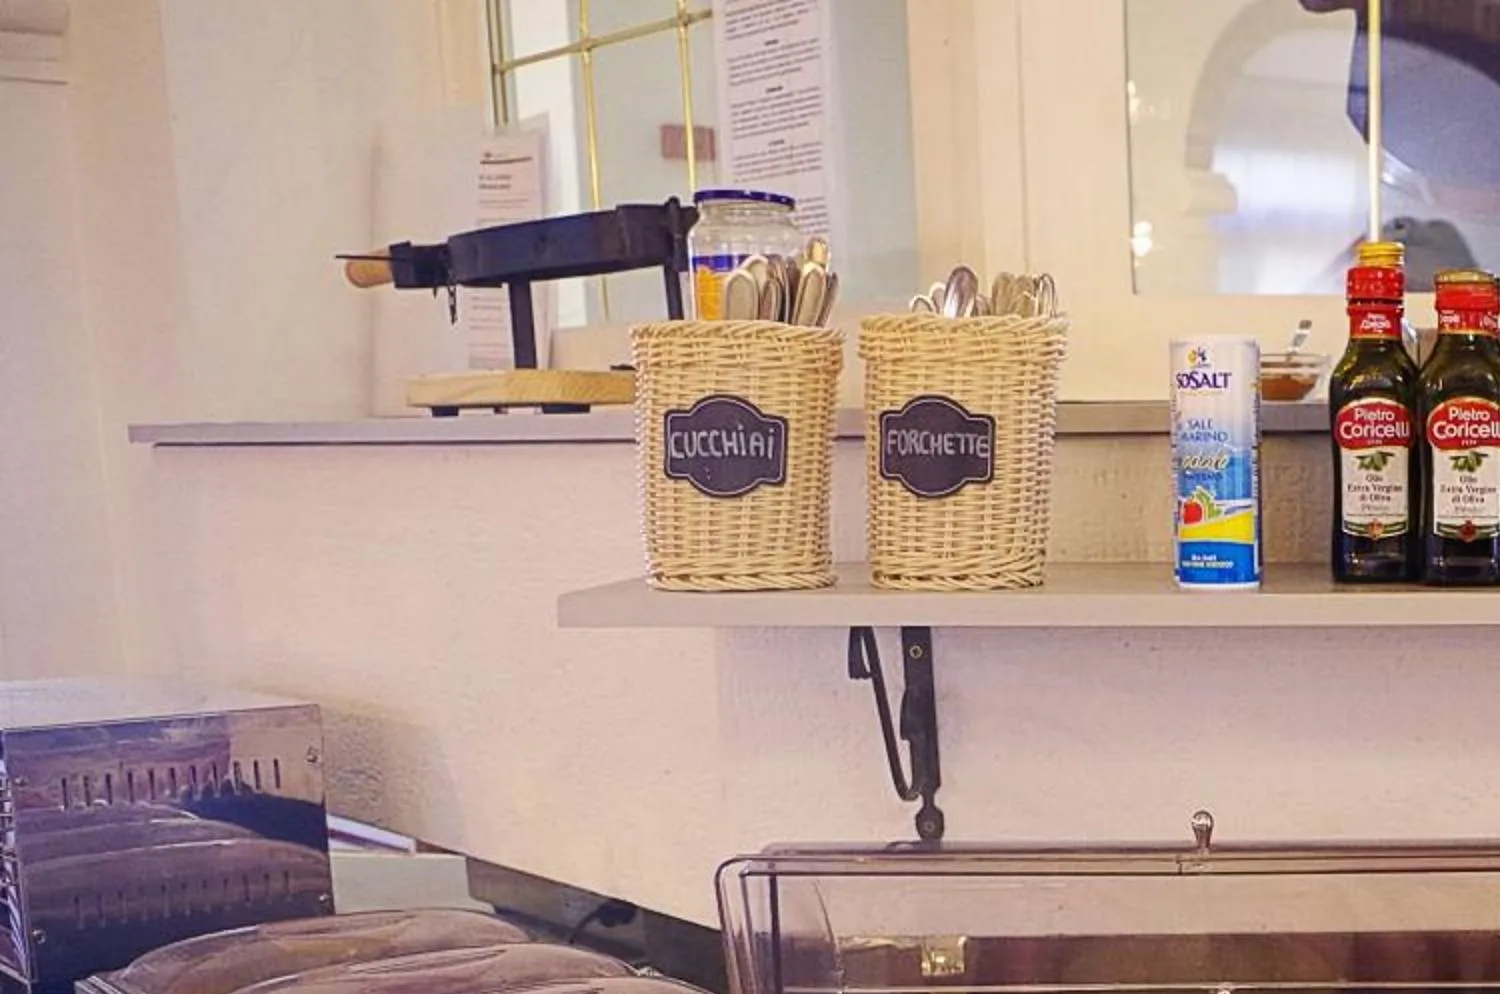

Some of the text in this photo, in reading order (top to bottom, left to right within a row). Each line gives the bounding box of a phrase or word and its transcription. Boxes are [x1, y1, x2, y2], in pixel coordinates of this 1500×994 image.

[1354, 407, 1396, 421] Pietro
[1448, 405, 1491, 421] Pietro
[1340, 420, 1411, 439] Coricelli
[887, 428, 991, 458] FORCHETTE
